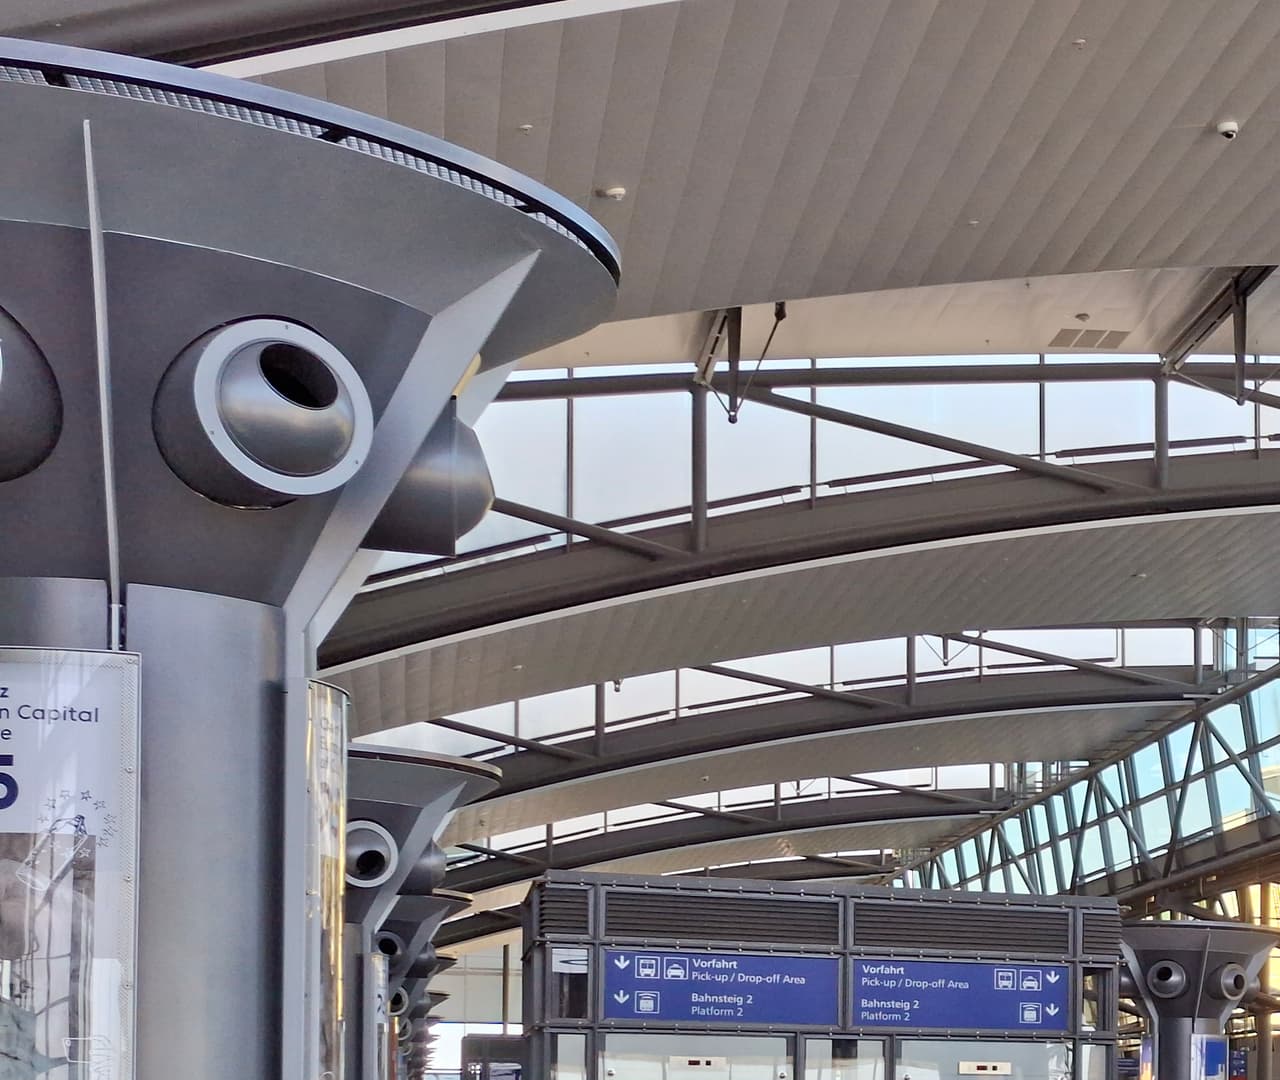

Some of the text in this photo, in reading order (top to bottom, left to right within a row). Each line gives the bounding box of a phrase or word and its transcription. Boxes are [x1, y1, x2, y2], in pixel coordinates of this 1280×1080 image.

[17, 704, 99, 724] Capital
[692, 958, 738, 969] Vorfahrt
[862, 964, 905, 975] Vorfahrt
[691, 971, 729, 984] Pick-up
[737, 973, 781, 985] Drop-off
[782, 975, 806, 985] Area
[861, 977, 897, 989] Pick-up
[904, 978, 945, 990] Drop-off
[947, 980, 970, 989] Area
[691, 993, 753, 1006] Bahnsteig 2
[861, 999, 920, 1011] Bahnsteig 2
[691, 1006, 744, 1017] Platform 2
[861, 1011, 911, 1021] Platform 2
